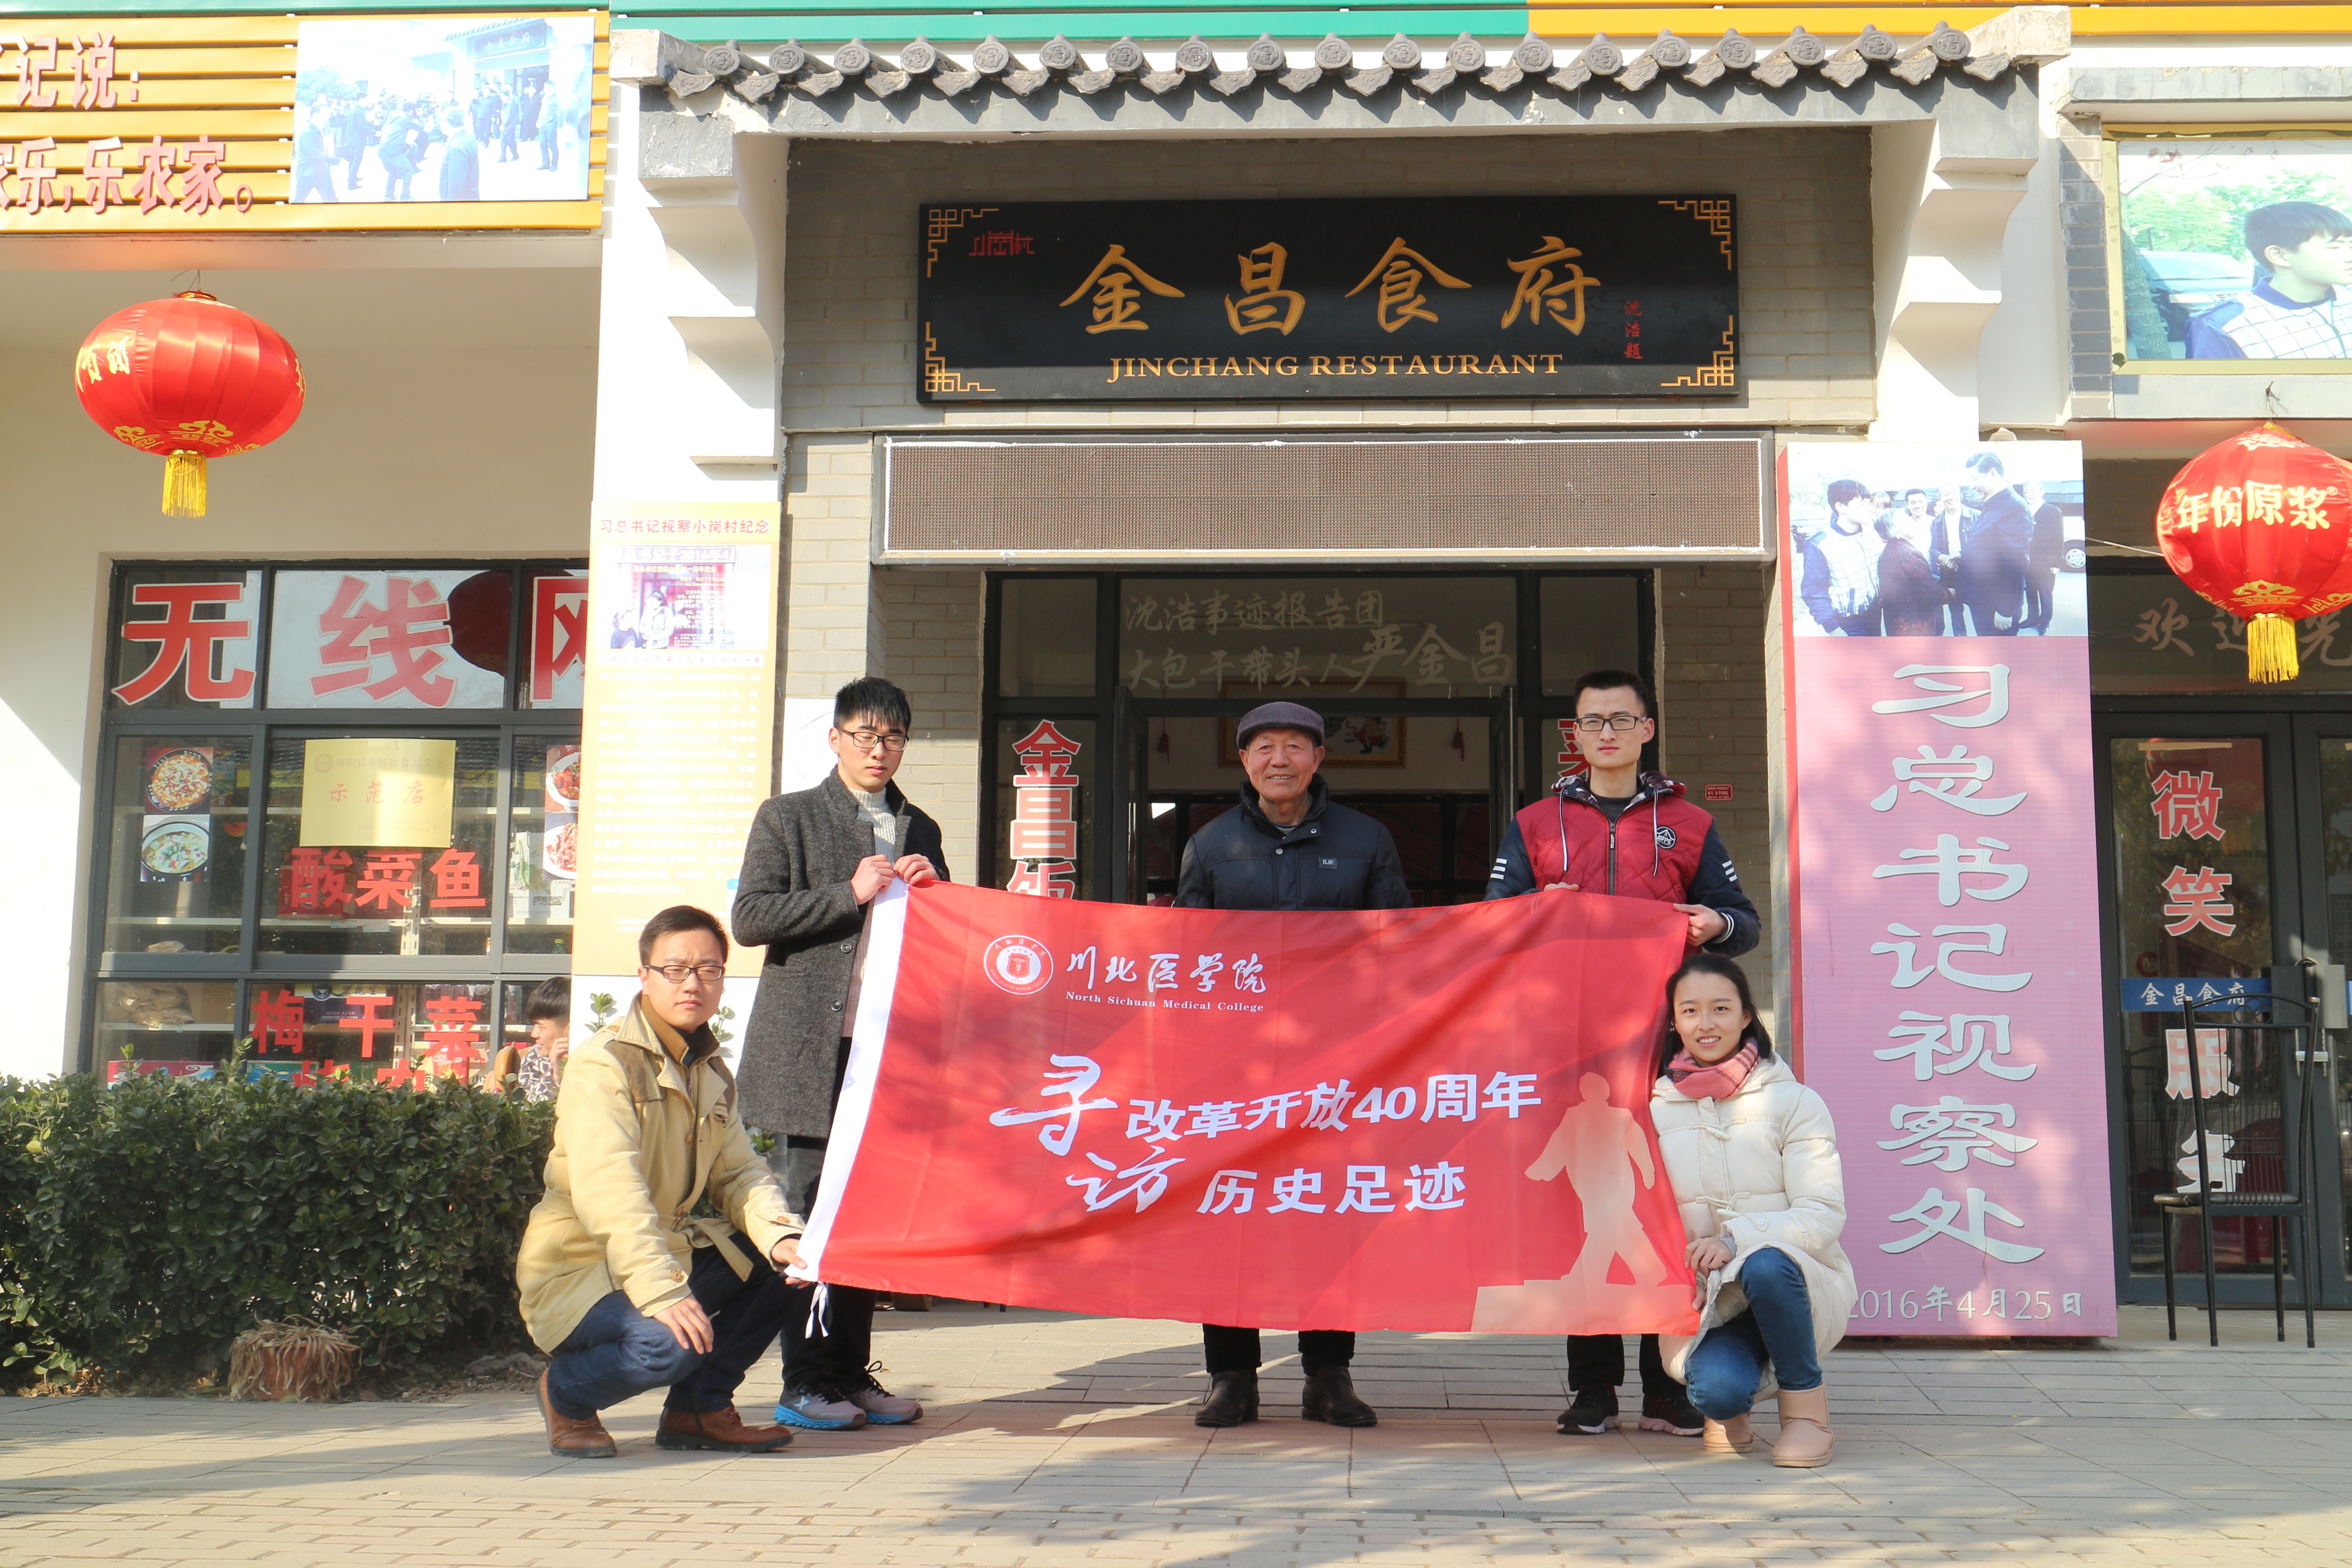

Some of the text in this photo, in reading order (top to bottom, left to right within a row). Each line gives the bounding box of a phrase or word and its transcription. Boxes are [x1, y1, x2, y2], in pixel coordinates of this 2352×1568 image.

[0, 30, 139, 111] 记说：
[1059, 236, 1601, 336] 金昌食府
[1624, 300, 1644, 359] 沈浩题
[1106, 353, 1563, 383] JINCHANG RESTAURANT
[600, 519, 771, 534] 习总书记视察小岗村纪念
[1124, 588, 1384, 635] 沈浩事迹报告团
[335, 757, 445, 769] 凤阳县小餐饮食品安全
[330, 779, 424, 805] 示范店
[290, 848, 486, 909] 酸菜鱼
[1066, 946, 1267, 994] 川北医学院
[1870, 663, 2045, 1264] 习总书记视察处
[1065, 991, 1264, 1013] North Sichuan Medical College
[2140, 981, 2244, 1007] 金昌食府
[252, 989, 482, 1059] 梅干菜
[1125, 1071, 1542, 1145] 改革开放40周年
[1196, 1161, 1466, 1215] 历史足迹
